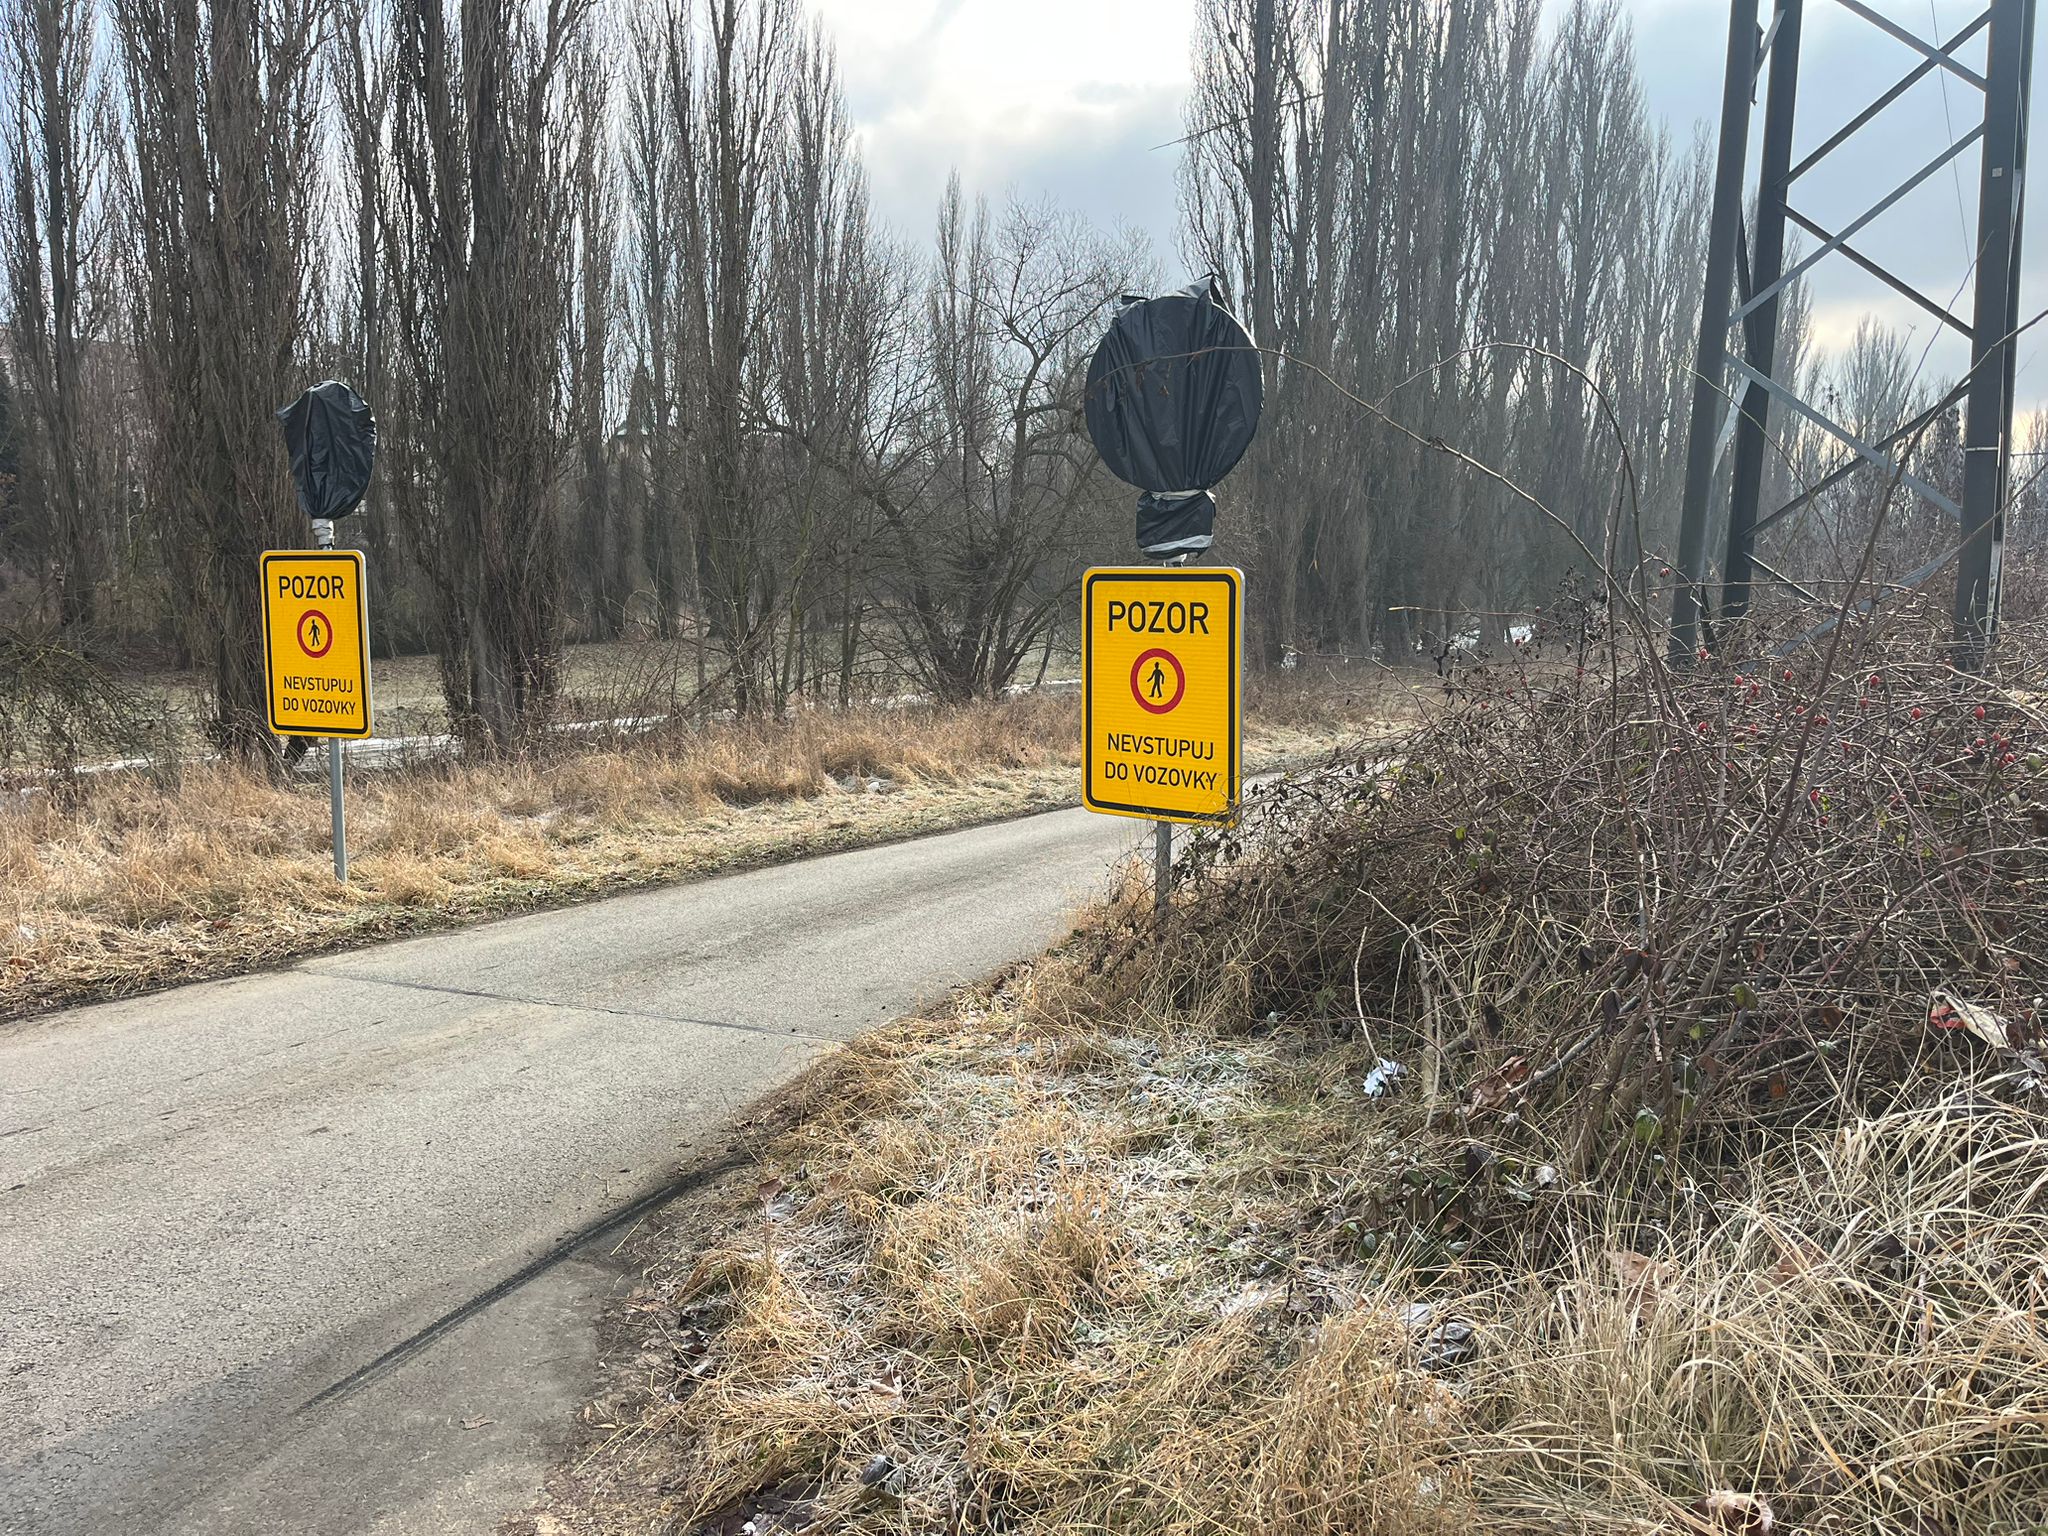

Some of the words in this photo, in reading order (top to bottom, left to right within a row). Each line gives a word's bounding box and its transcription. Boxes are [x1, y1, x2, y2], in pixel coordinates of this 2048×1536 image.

[279, 575, 345, 599] POZOR
[1108, 601, 1209, 634] POZOR
[283, 676, 353, 693] NEVSTUPUJ
[283, 697, 299, 712] DO
[302, 699, 356, 715] VOZOVKY
[1107, 733, 1214, 761] NEVSTUPUJ
[1105, 761, 1128, 780] DO
[1133, 764, 1218, 791] VOZOVKY
